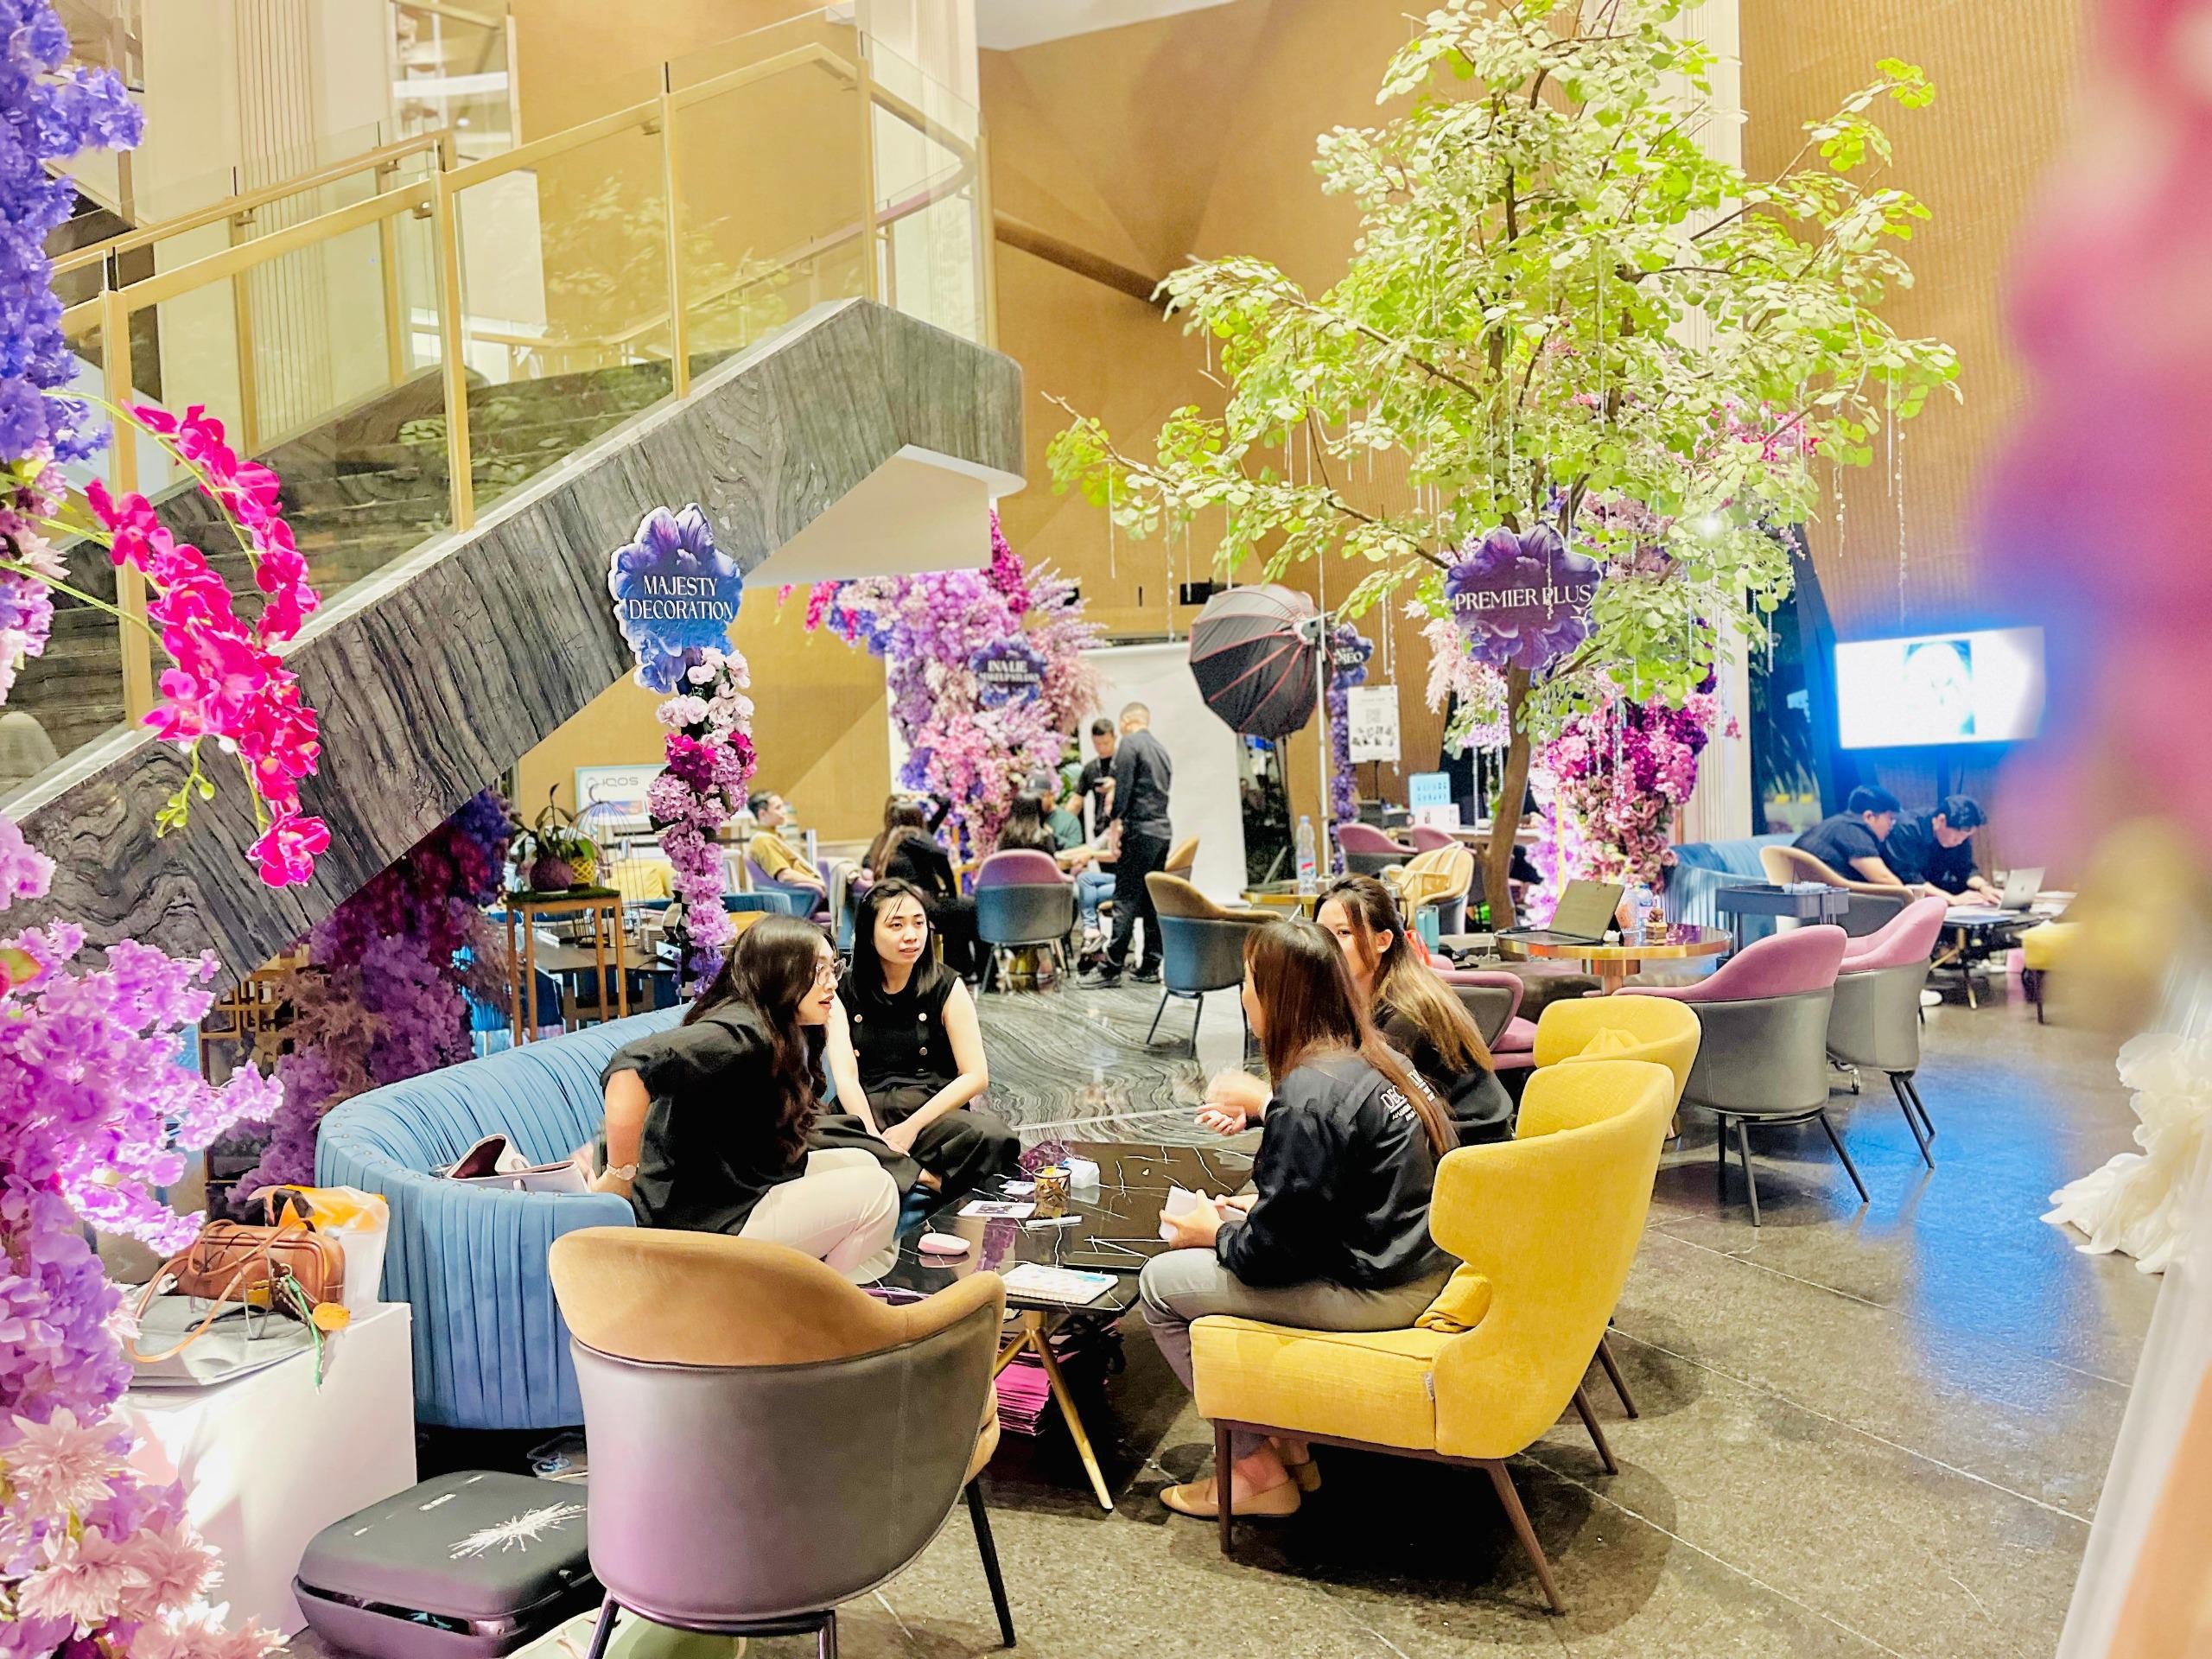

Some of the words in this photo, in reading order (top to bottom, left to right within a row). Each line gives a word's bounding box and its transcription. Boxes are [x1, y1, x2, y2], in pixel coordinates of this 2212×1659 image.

[643, 575, 718, 596] MAJESTY
[1454, 588, 1538, 611] PREMIER
[1541, 584, 1592, 606] PLUS
[628, 600, 734, 620] DECORATION
